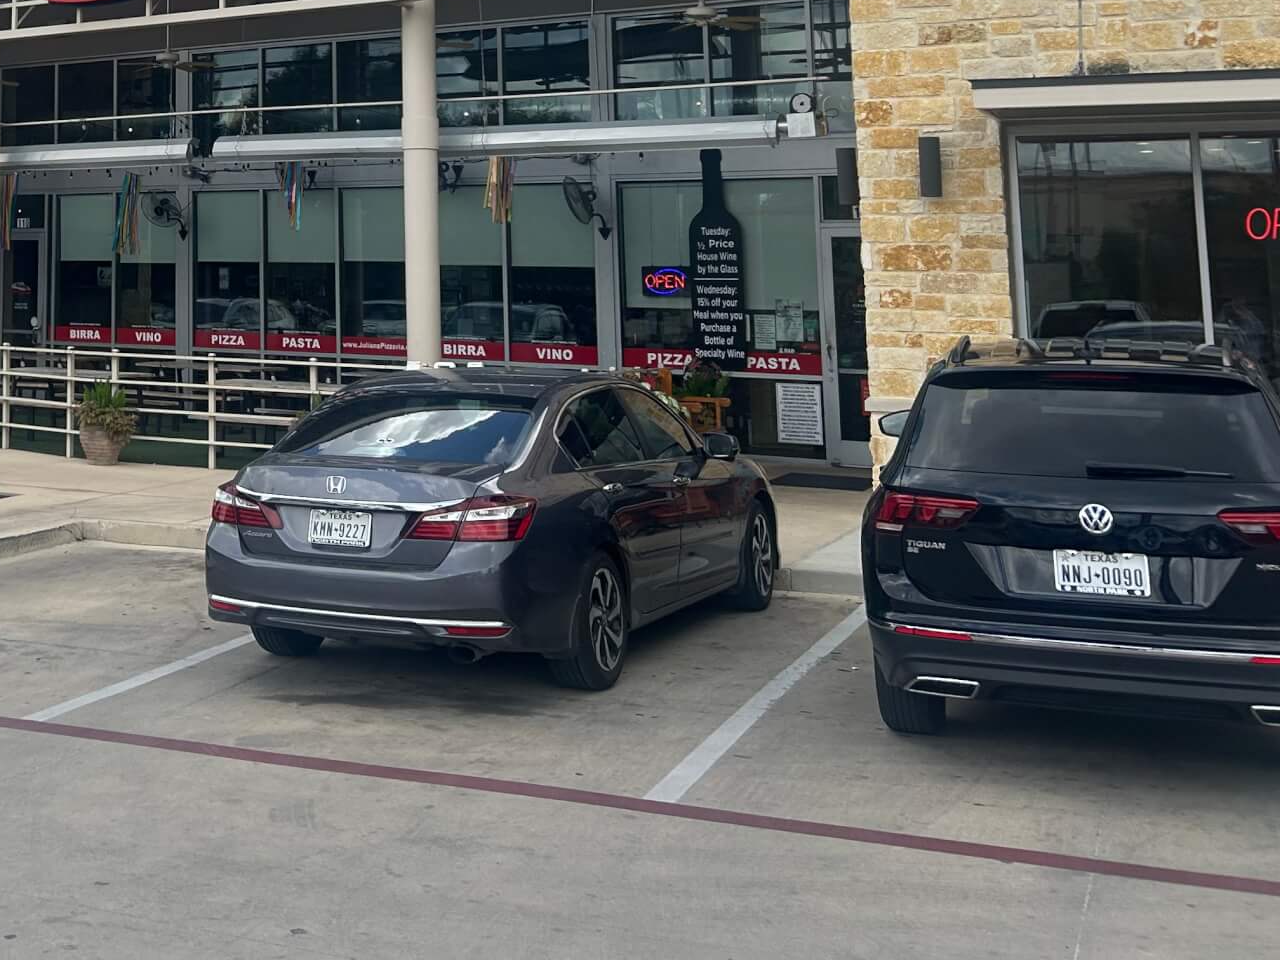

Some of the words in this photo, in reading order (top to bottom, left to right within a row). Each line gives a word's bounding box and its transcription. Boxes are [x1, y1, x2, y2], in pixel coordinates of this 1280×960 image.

[708, 239, 735, 248] Price
[697, 251, 718, 261] House
[719, 251, 737, 261] Wine
[697, 264, 706, 275] by
[707, 264, 718, 273] the
[720, 264, 738, 273] Glass
[644, 273, 686, 289] OPEN
[711, 297, 721, 307] off
[722, 299, 738, 308] your
[693, 310, 709, 319] Meal
[710, 310, 729, 319] when
[729, 312, 743, 321] you
[700, 322, 731, 332] Purchase
[69, 329, 101, 340] BIRRA
[135, 332, 162, 342] VINO
[211, 334, 246, 346] PIZZA
[704, 335, 725, 345] Bottle
[726, 335, 734, 345] of
[282, 337, 320, 349] PASTA
[443, 343, 486, 356] BIRRA
[536, 348, 573, 361] VINO
[695, 348, 726, 359] Specialty
[726, 348, 745, 358] Wine
[647, 352, 693, 366] PIZZA
[747, 357, 800, 370] PASTA
[330, 512, 353, 520] TEXAS
[906, 539, 946, 549] TIGUAN
[1084, 554, 1118, 563] TEXAS
